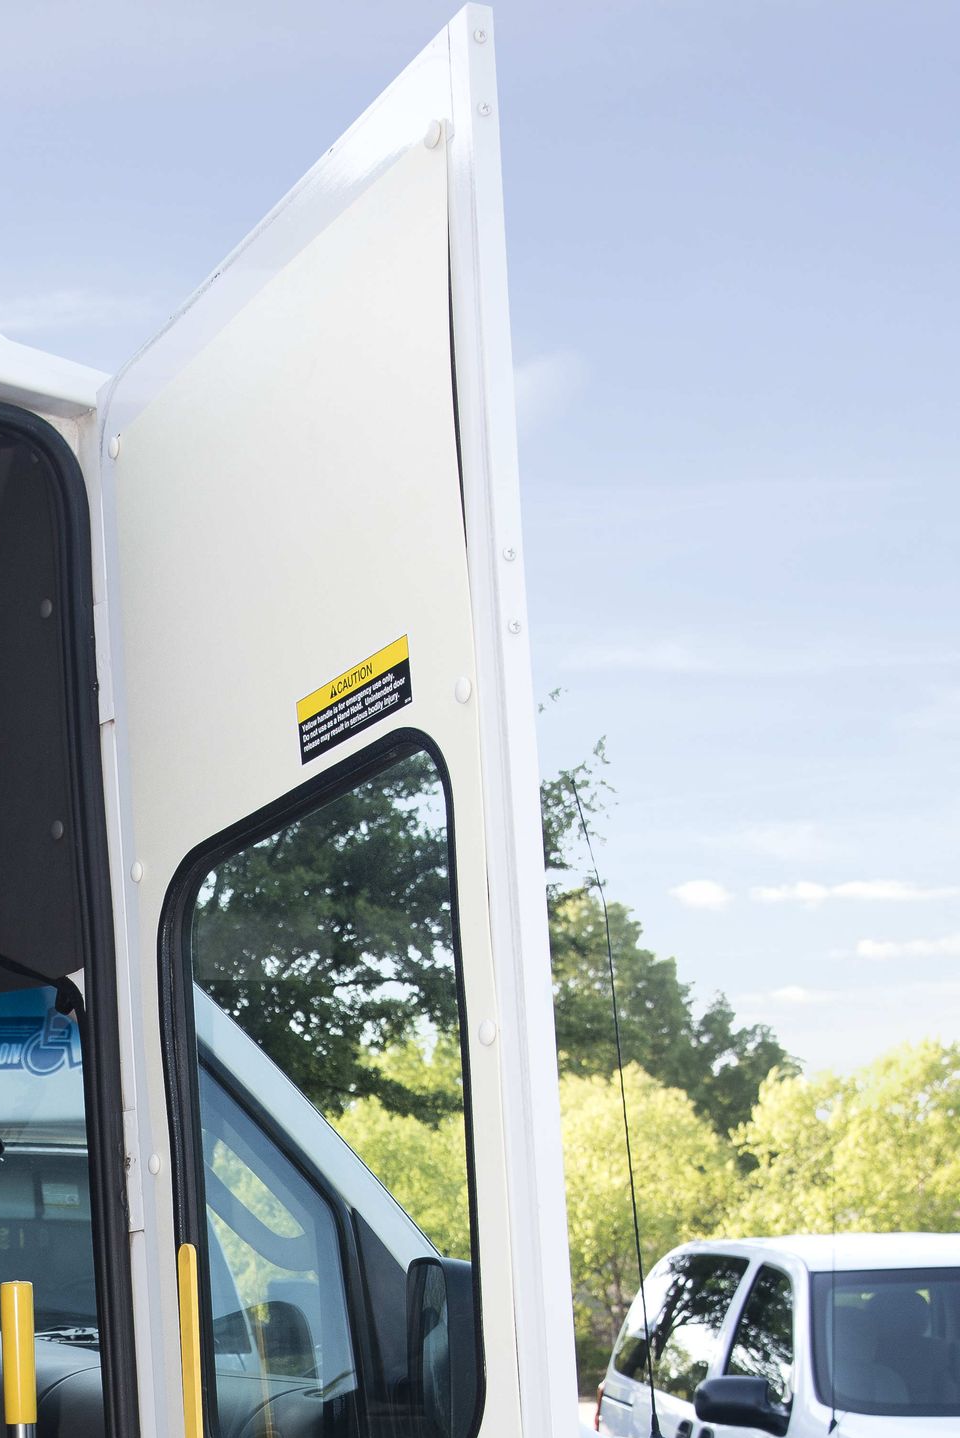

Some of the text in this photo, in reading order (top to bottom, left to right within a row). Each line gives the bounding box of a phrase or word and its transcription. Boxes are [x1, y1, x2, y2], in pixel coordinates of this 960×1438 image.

[302, 720, 317, 732] Yellow
[317, 710, 333, 723] handle
[333, 706, 338, 714] is
[346, 687, 371, 706] emergency
[372, 680, 382, 690] use
[382, 673, 395, 684] only.
[337, 663, 372, 693] CAUTION
[303, 734, 310, 743] Do
[310, 728, 318, 738] not
[318, 724, 327, 733] use
[337, 709, 350, 722] Hand
[350, 702, 363, 714] Hold.
[365, 684, 392, 705] Unintended
[393, 677, 405, 689] door
[304, 739, 320, 752] release
[320, 733, 330, 743] may
[331, 723, 344, 736] result
[350, 711, 367, 725] serious
[368, 701, 383, 716] bodily
[384, 692, 400, 707] injury.
